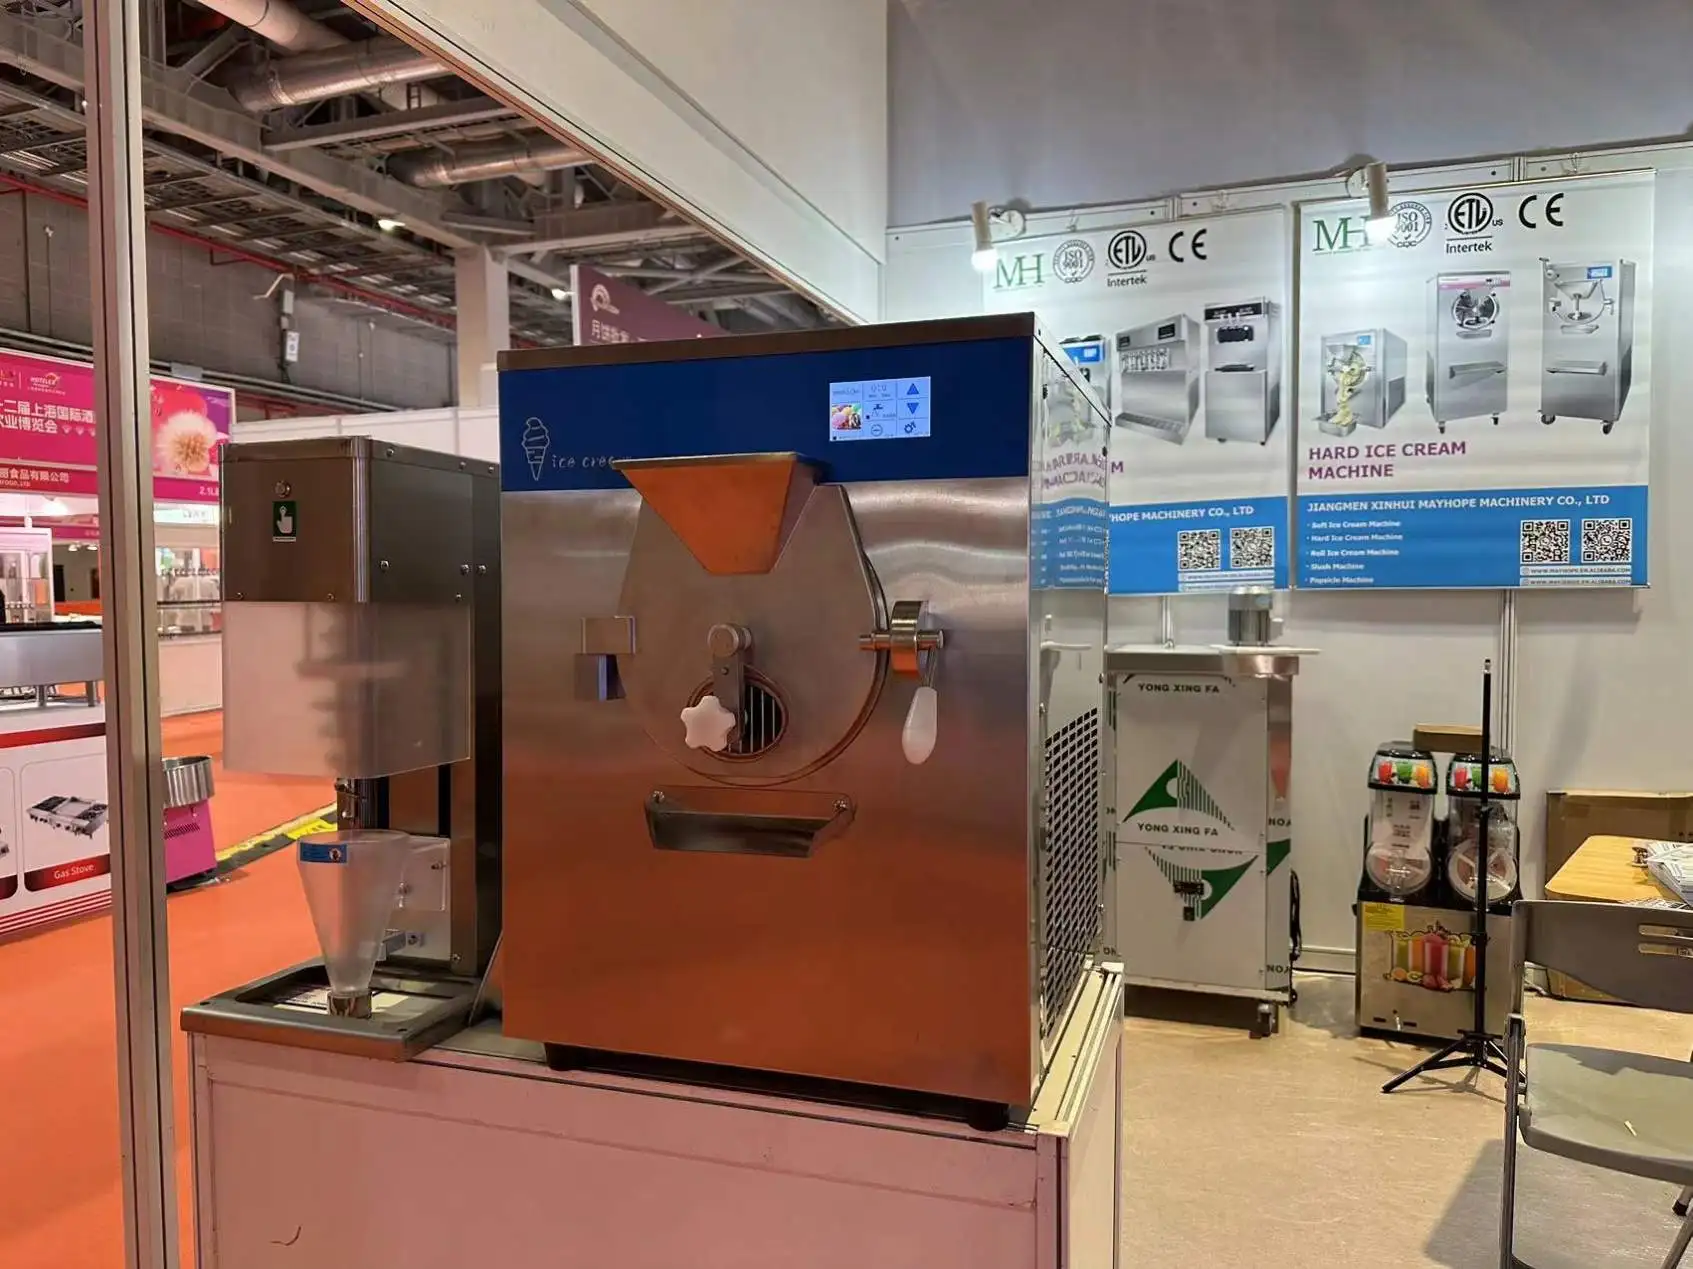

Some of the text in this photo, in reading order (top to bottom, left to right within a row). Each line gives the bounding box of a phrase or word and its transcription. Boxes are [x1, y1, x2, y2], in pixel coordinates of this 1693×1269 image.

[1397, 211, 1418, 222] ISO
[1519, 193, 1564, 228] CE
[1169, 229, 1207, 262] CE
[1446, 241, 1492, 253] Intertek
[1064, 250, 1083, 262] ISO
[992, 253, 1045, 288] MH
[1107, 274, 1147, 287] Intertek
[1308, 441, 1466, 460] HARD ICE CREAM
[552, 454, 576, 468] ice
[1308, 464, 1394, 479] MACHINE
[1307, 495, 1609, 512] JIANGMEN XINHUI MAYHOPE MACHINERY CO., LTD
[1109, 512, 1142, 522] HOPE
[1142, 508, 1206, 521] MACHINERY
[1233, 506, 1254, 516] LTD
[1342, 576, 1374, 584] Machine
[1138, 683, 1219, 693] YONG XING FA
[1137, 823, 1218, 836] YONG XING FA
[54, 865, 94, 879] Gas Stove
